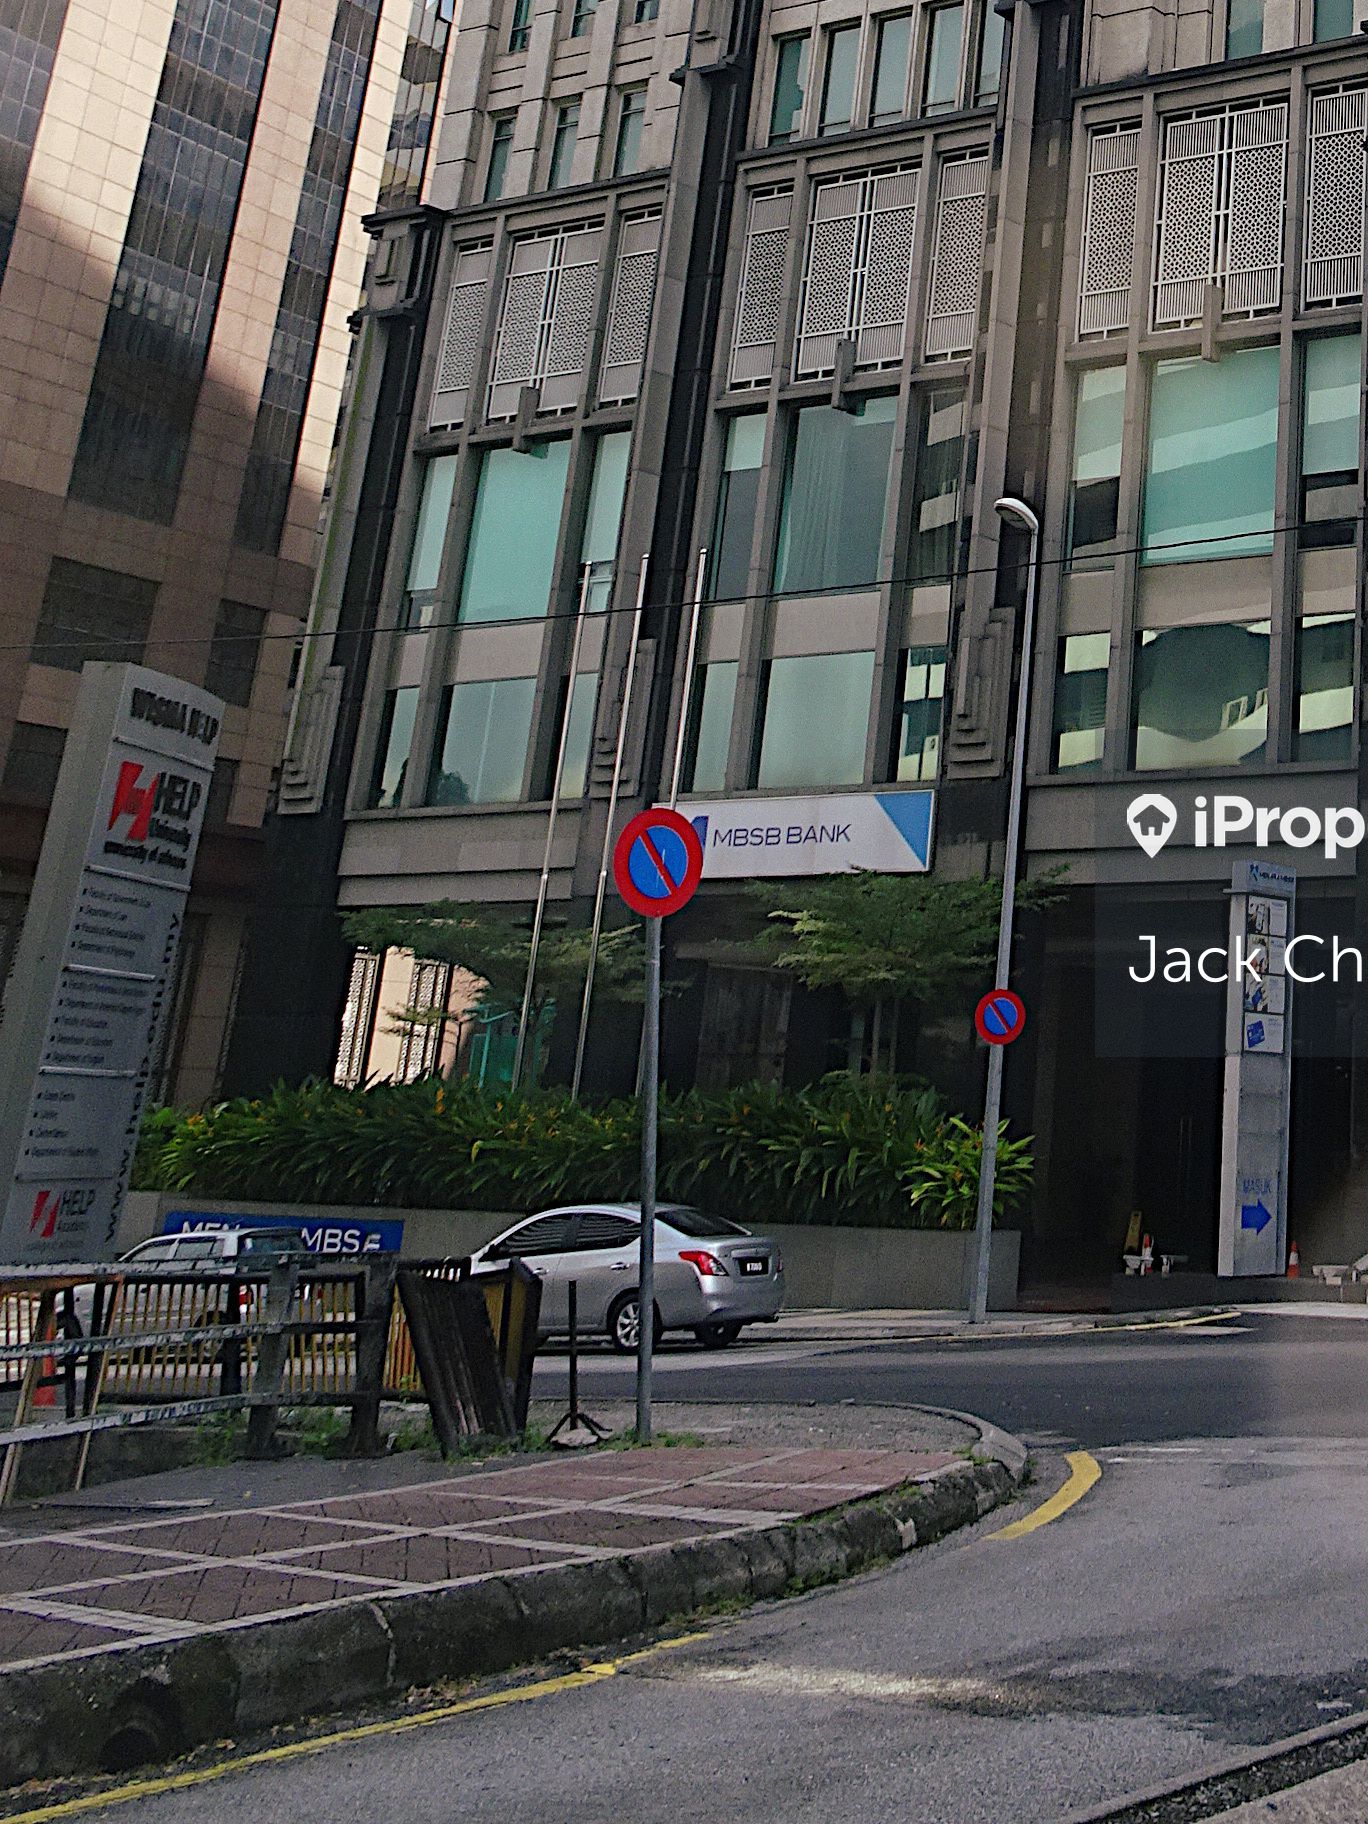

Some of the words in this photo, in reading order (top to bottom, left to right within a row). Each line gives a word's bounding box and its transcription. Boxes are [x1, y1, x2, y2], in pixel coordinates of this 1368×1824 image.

[131, 688, 188, 733] WISMA
[187, 708, 219, 745] HELP
[154, 773, 202, 821] HELP
[713, 827, 781, 847] MBSB
[786, 824, 852, 844] BANK
[60, 1189, 96, 1217] HELP
